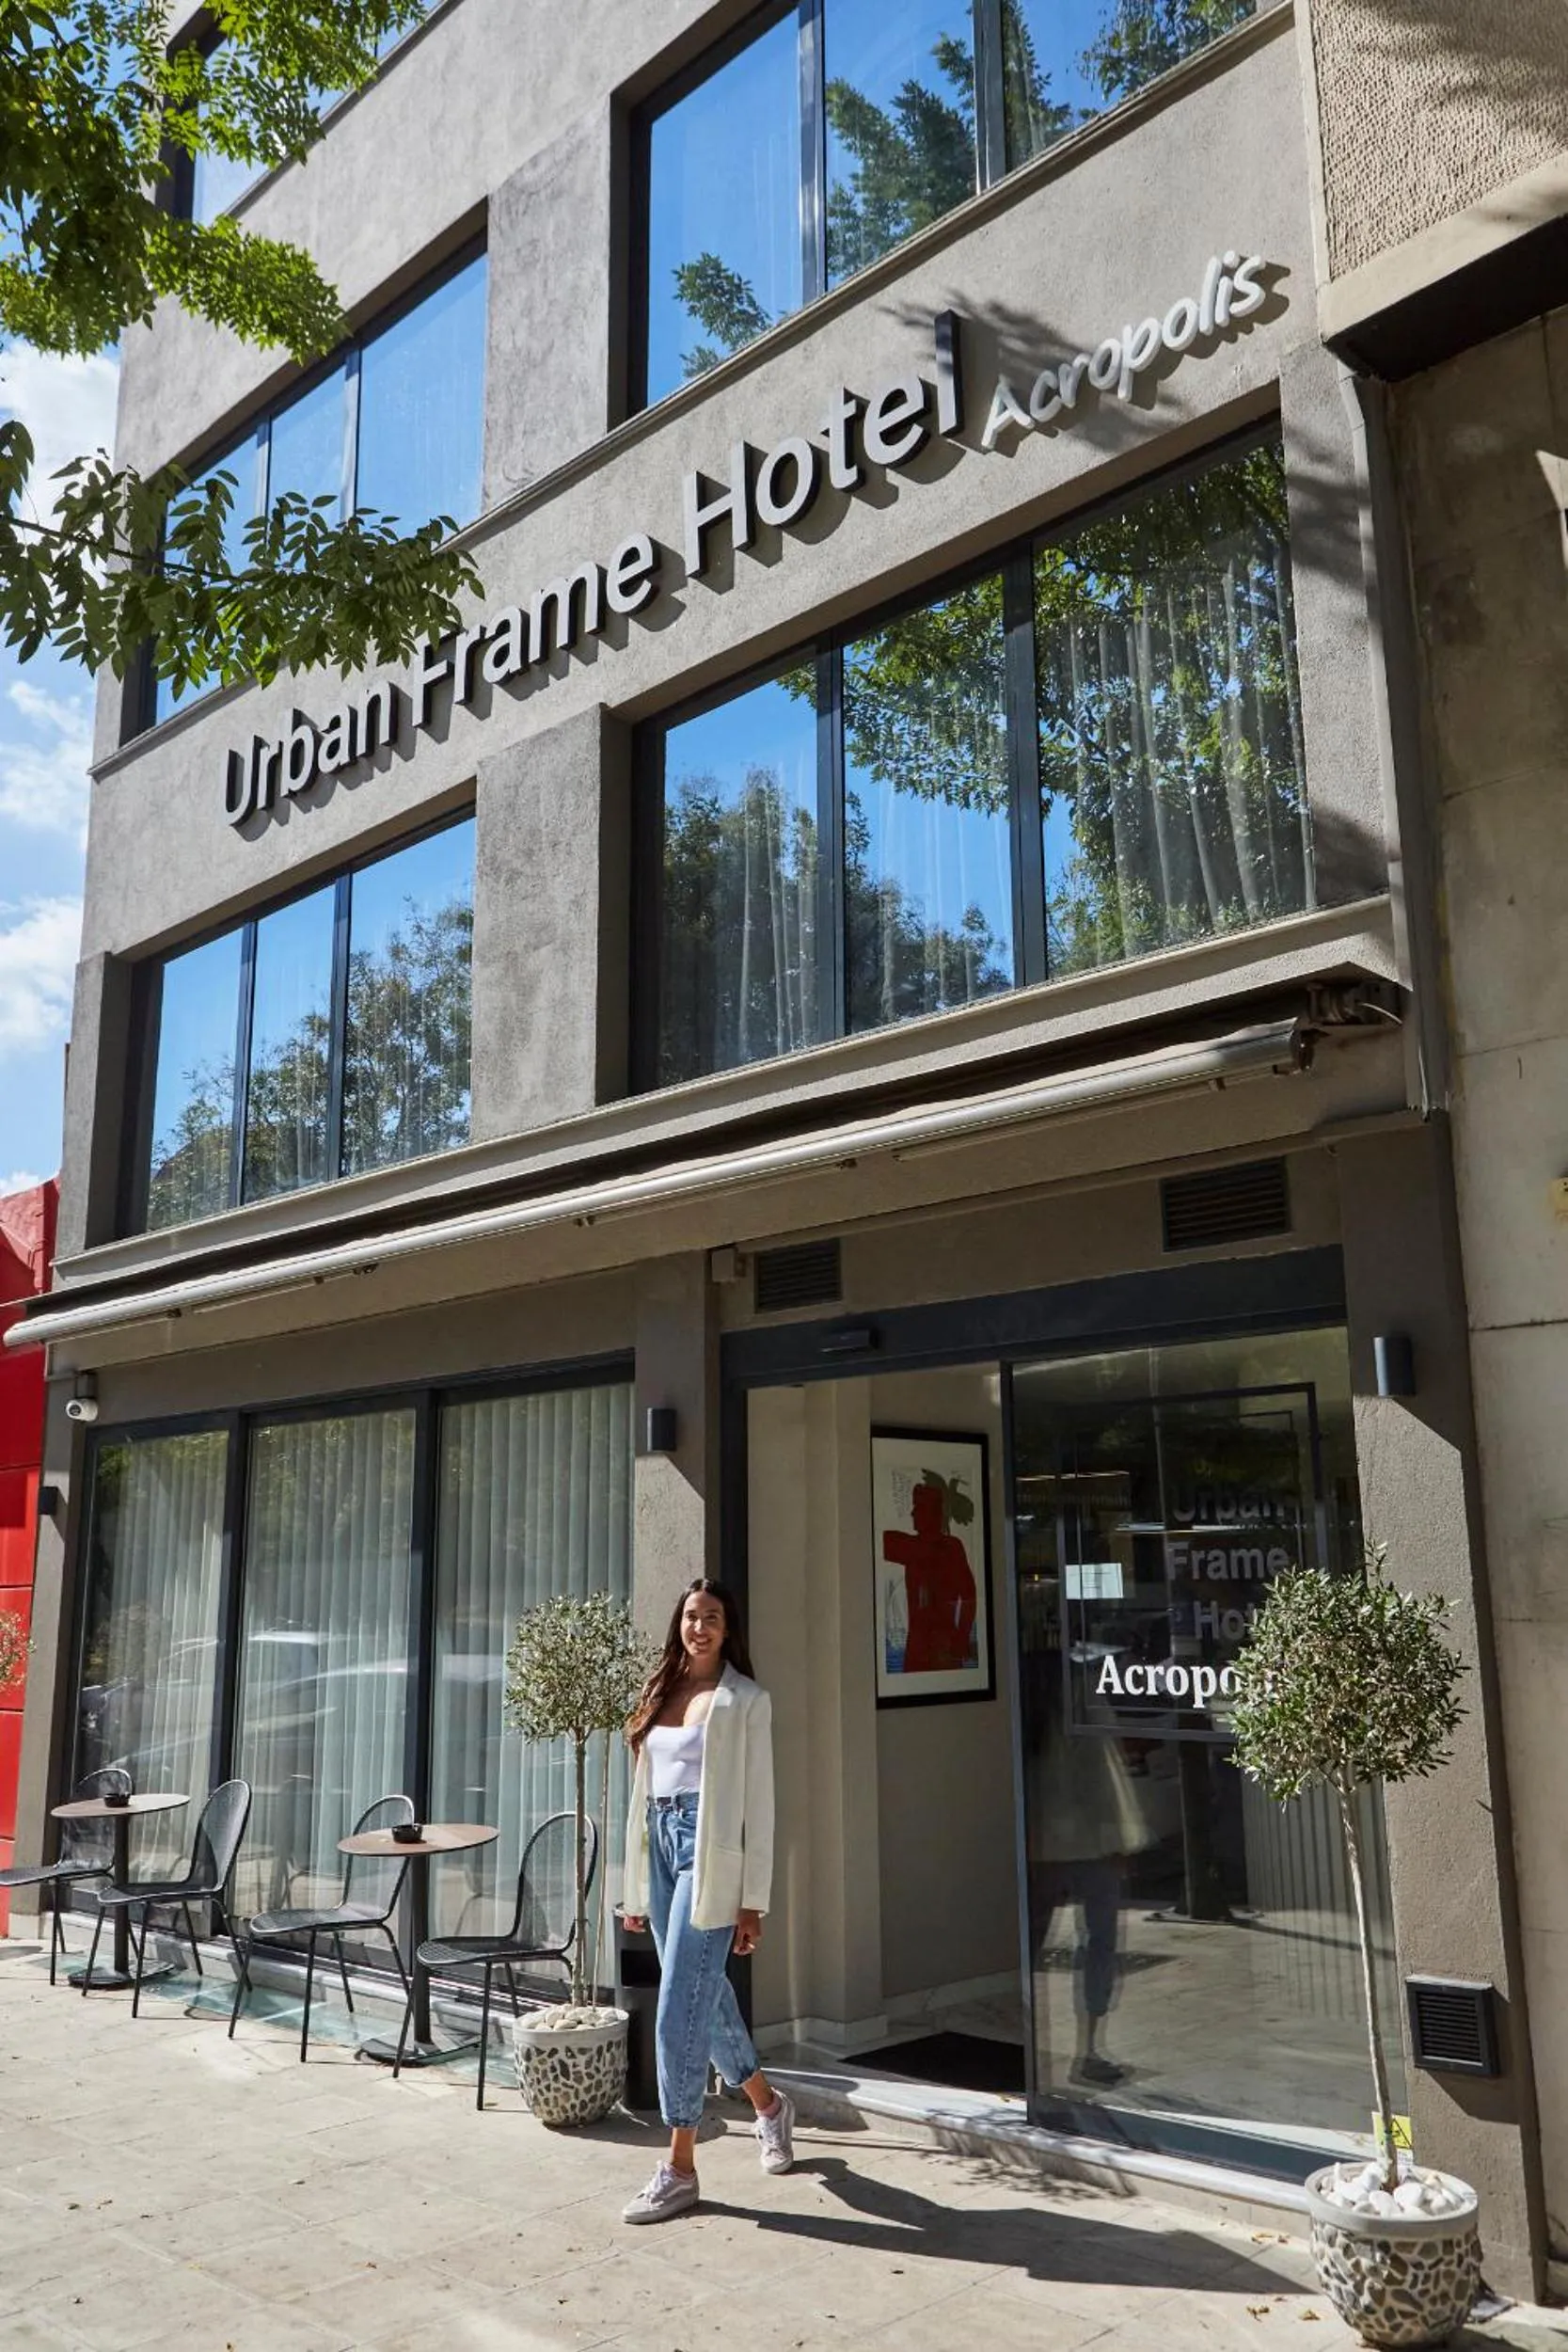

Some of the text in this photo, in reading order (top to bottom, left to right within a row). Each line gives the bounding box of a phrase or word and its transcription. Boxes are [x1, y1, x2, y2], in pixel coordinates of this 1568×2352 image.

[223, 250, 1266, 827] Urban Frame Hotel Acropolis
[1172, 1482, 1286, 1523] Urban
[1167, 1540, 1290, 1581] Frame
[1095, 1653, 1276, 1708] Acropo
